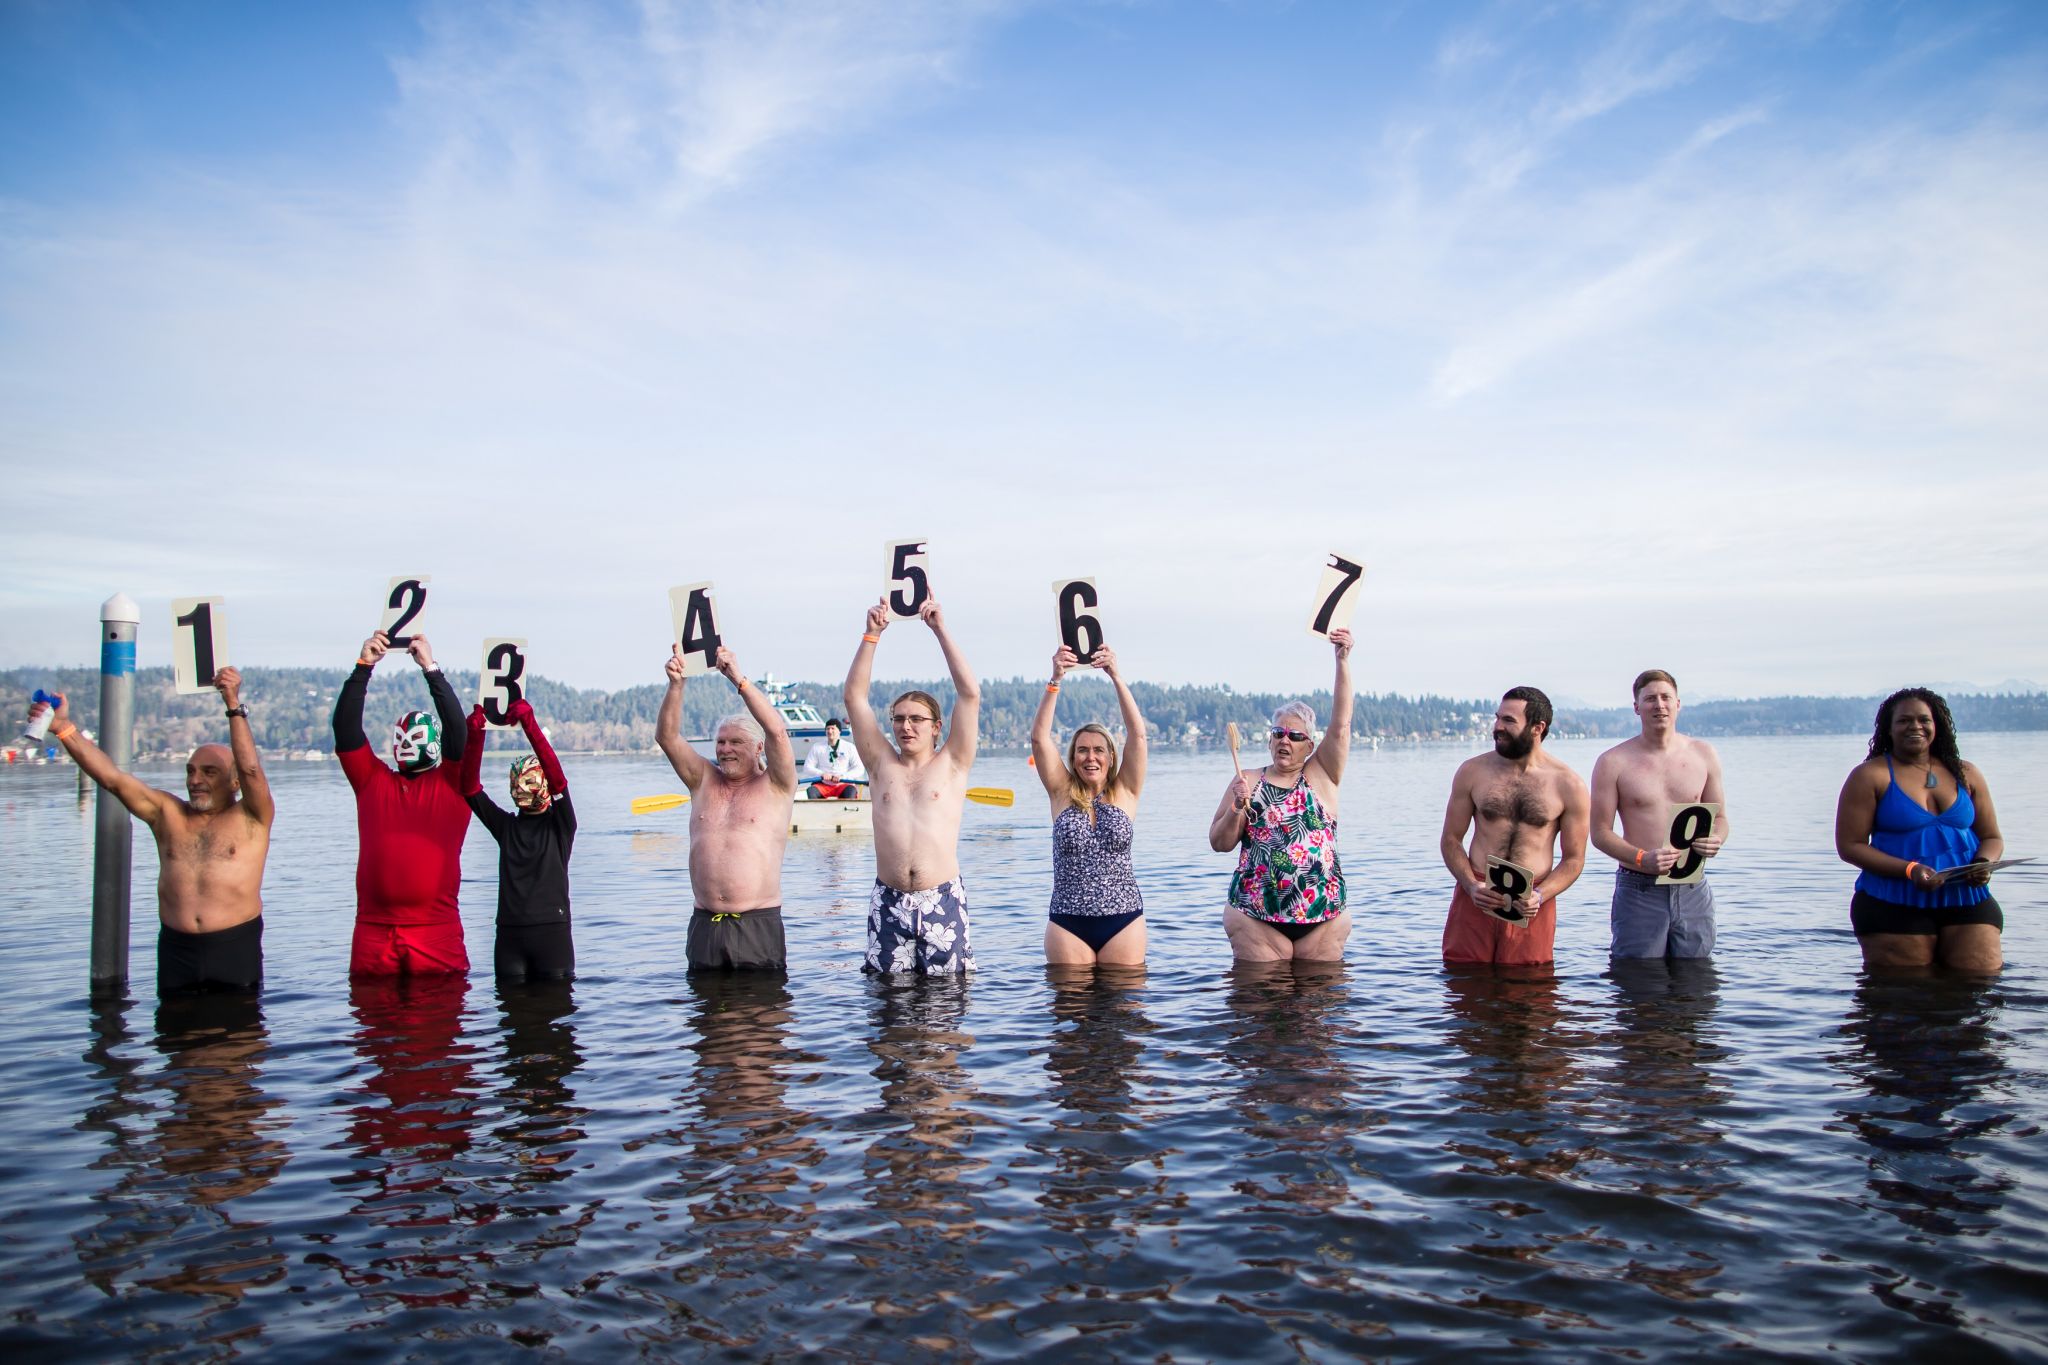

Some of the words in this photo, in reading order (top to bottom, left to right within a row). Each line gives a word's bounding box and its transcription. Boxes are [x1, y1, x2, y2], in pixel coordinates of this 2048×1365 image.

[387, 580, 426, 648] 2
[890, 543, 928, 616] 5
[1313, 554, 1362, 635] 7
[177, 603, 215, 687] 1
[682, 588, 722, 668] 4
[1059, 581, 1103, 664] 6
[483, 643, 524, 726] 3
[1668, 806, 1712, 879] 9
[1489, 864, 1528, 921] 8
